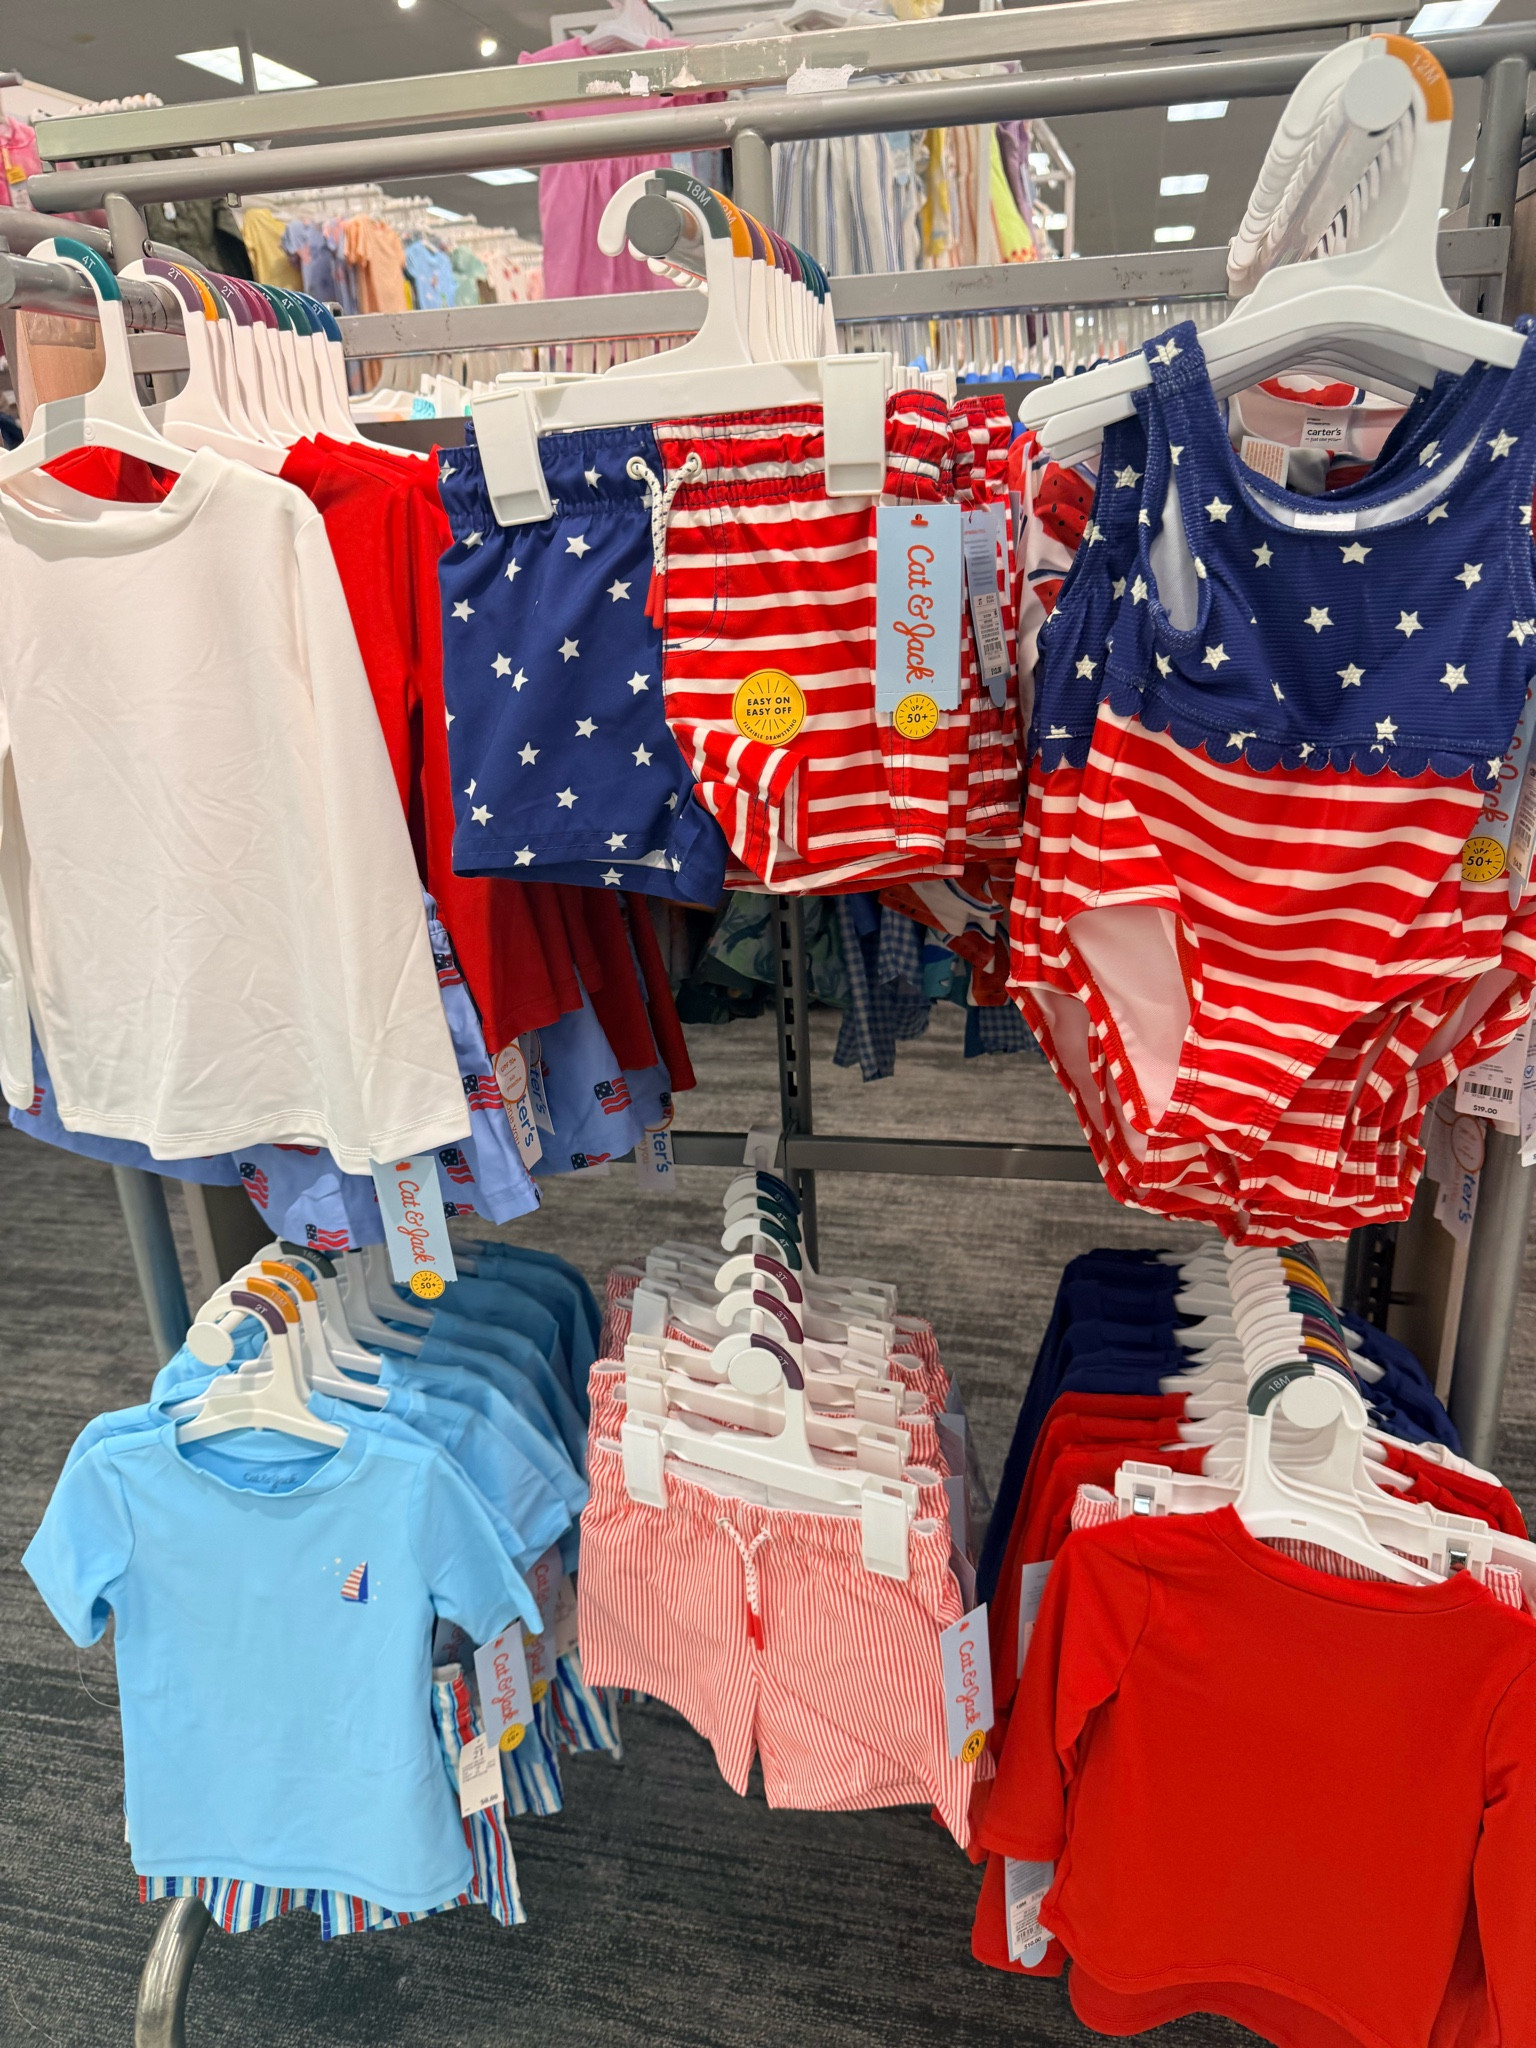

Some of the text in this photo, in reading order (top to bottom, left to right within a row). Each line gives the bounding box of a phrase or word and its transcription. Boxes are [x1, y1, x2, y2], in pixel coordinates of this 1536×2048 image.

[1411, 52, 1442, 85] 12M
[686, 180, 712, 207] 18M
[82, 255, 96, 269] 4T
[167, 267, 182, 281] 2T
[220, 285, 235, 298] 2T
[281, 298, 295, 310] 4T
[311, 303, 324, 315] 5T
[1307, 427, 1342, 436] carter's
[892, 544, 936, 685] Cat & Jack
[747, 696, 791, 706] EASY ON
[746, 706, 792, 716] EASY OFF
[906, 712, 928, 724] 50+
[743, 718, 797, 741] FLEXIBLE DRAWSTRING
[1466, 856, 1493, 867] 50+
[530, 1069, 547, 1115] ter's
[1472, 1104, 1498, 1115] $19.00
[516, 1094, 536, 1148] ter's
[652, 1131, 673, 1173] ter's
[1458, 1173, 1476, 1224] ter's
[397, 1180, 436, 1265] Cat & Jack
[776, 1212, 787, 1221] 4T
[779, 1238, 790, 1248] 4T
[775, 1271, 788, 1281] 3T
[420, 1282, 437, 1290] 50+
[254, 1303, 268, 1315] 2T
[776, 1310, 789, 1321] 3T
[777, 1355, 789, 1367] 2T
[1268, 1375, 1291, 1392] 18M
[959, 1640, 974, 1673] Cat
[962, 1670, 976, 1688] &
[491, 1653, 519, 1726] Cat & Jack
[955, 1686, 981, 1730] Jack
